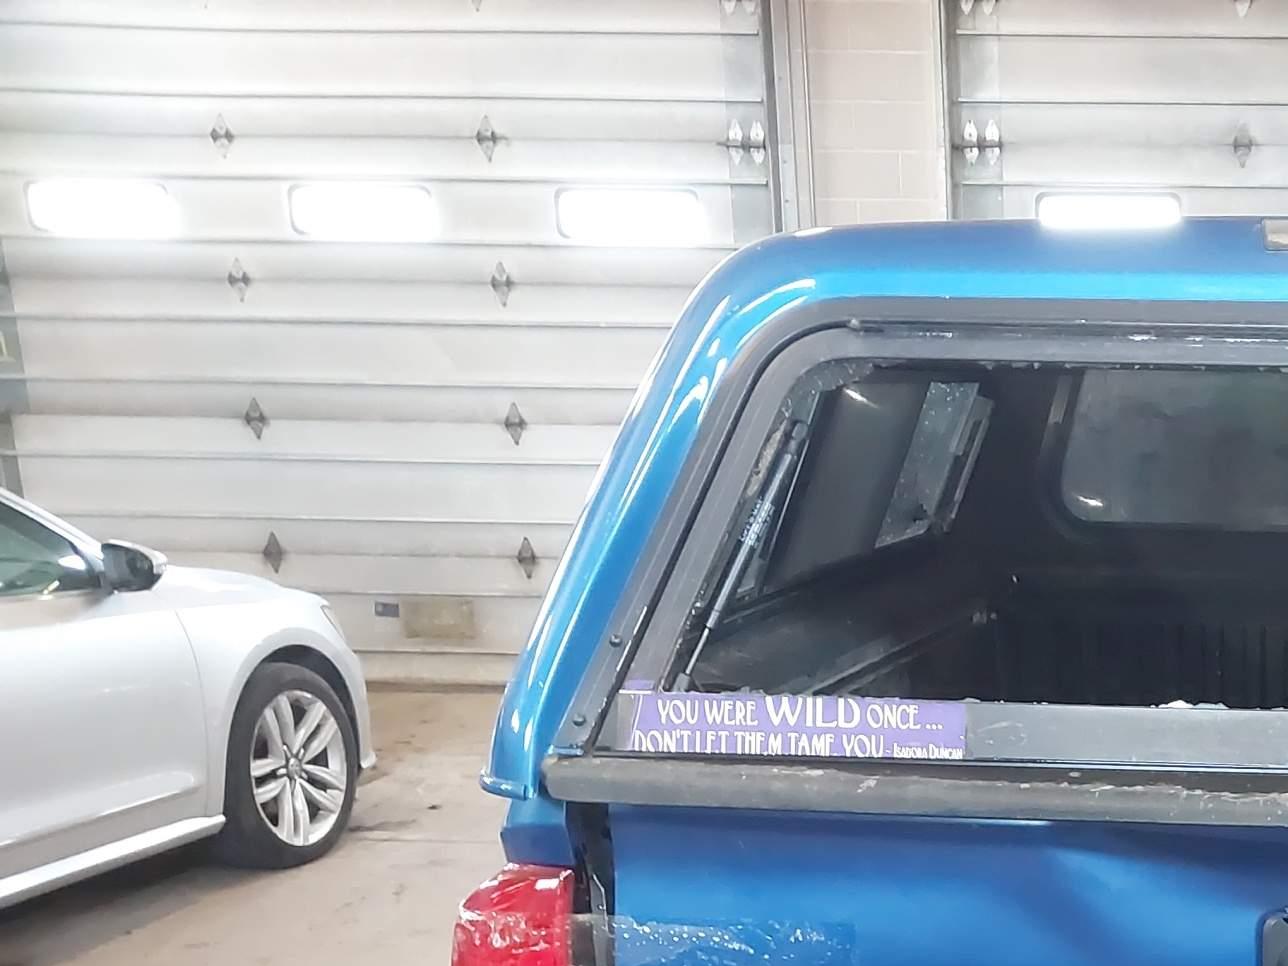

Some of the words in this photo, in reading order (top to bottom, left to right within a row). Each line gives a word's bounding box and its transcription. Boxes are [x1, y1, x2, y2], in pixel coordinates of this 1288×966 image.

[657, 699, 699, 725] YOU
[704, 700, 758, 726] WERE
[765, 696, 861, 729] WILD
[634, 729, 692, 753] DON'T
[695, 730, 730, 755] LET
[734, 732, 783, 757] THEM
[788, 732, 835, 757] TAME
[842, 734, 884, 759] YOU
